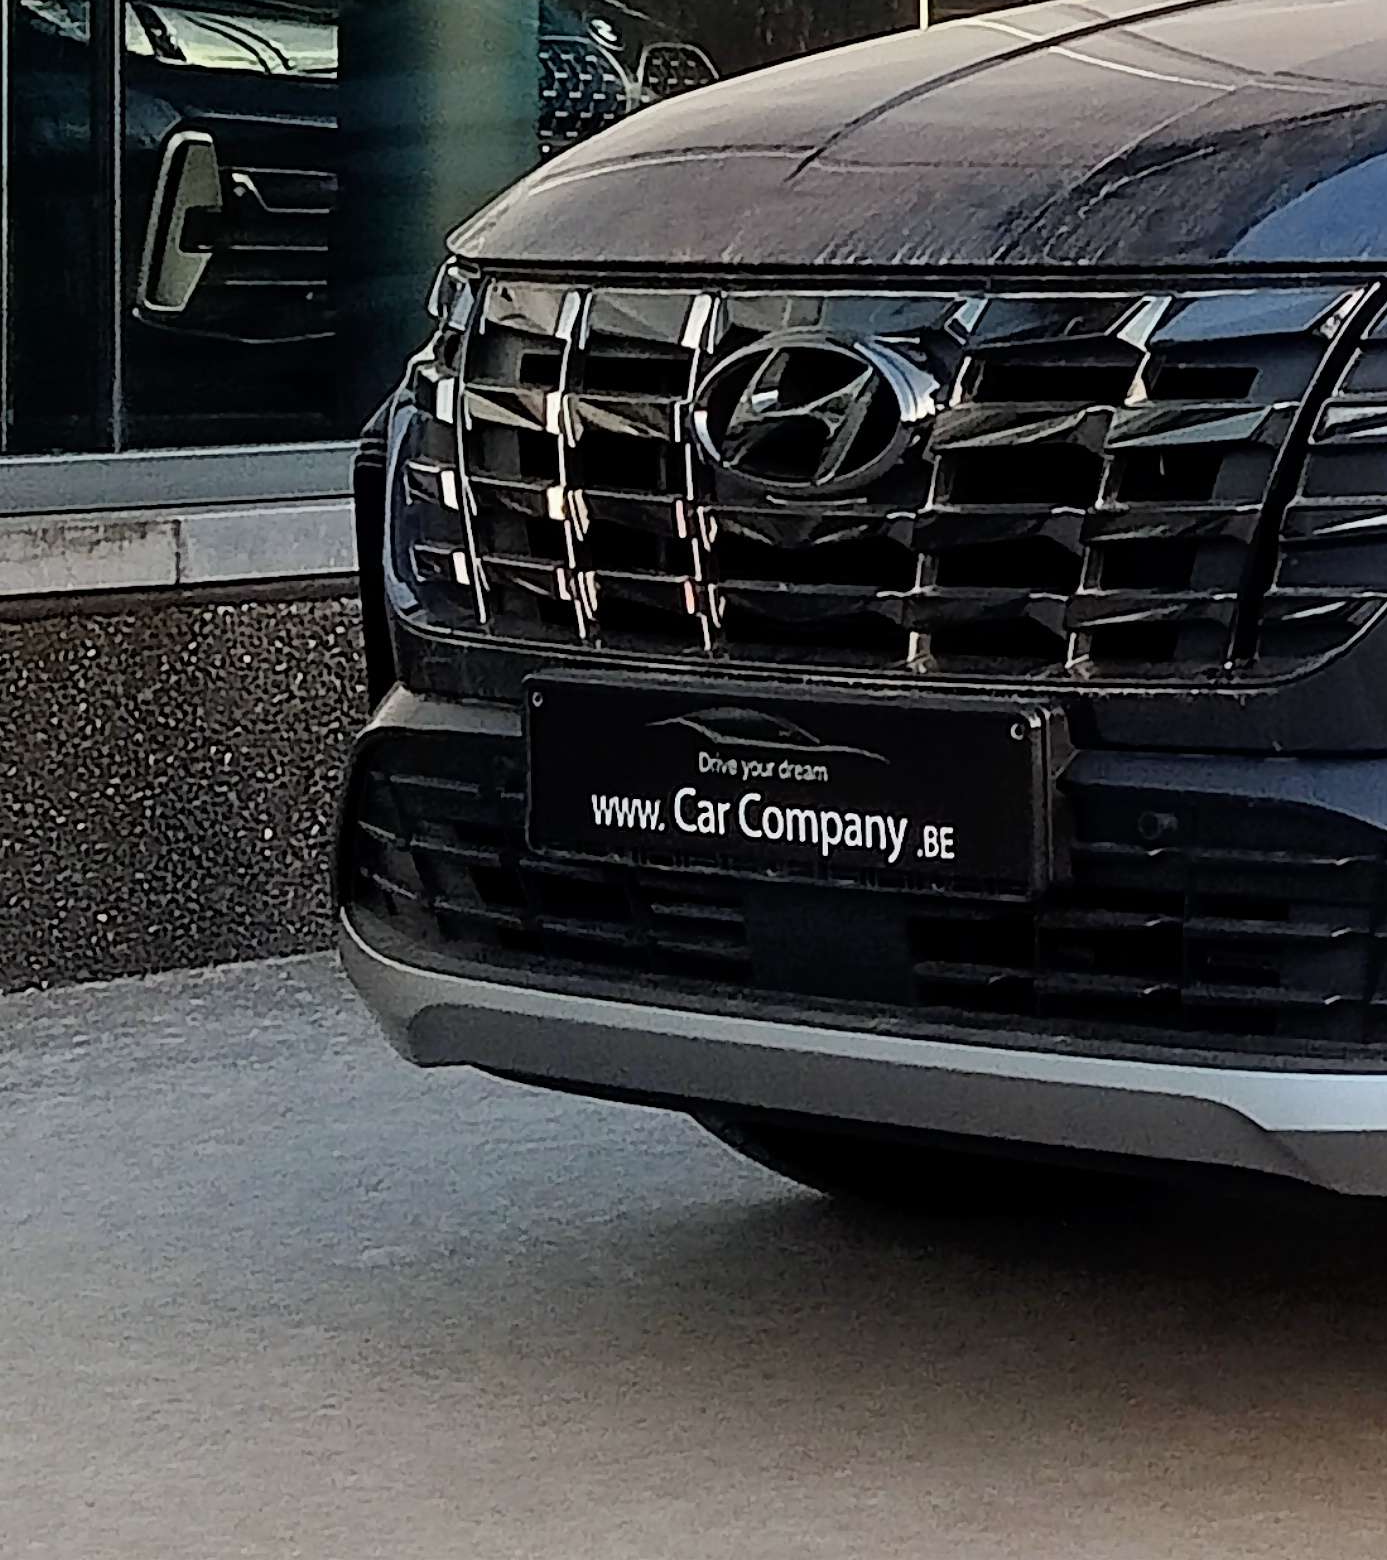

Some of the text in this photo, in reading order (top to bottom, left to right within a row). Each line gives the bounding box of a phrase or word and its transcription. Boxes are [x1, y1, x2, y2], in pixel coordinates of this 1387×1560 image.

[698, 751, 829, 782] Drive your dream
[591, 786, 956, 864] www. Car Company .BE
